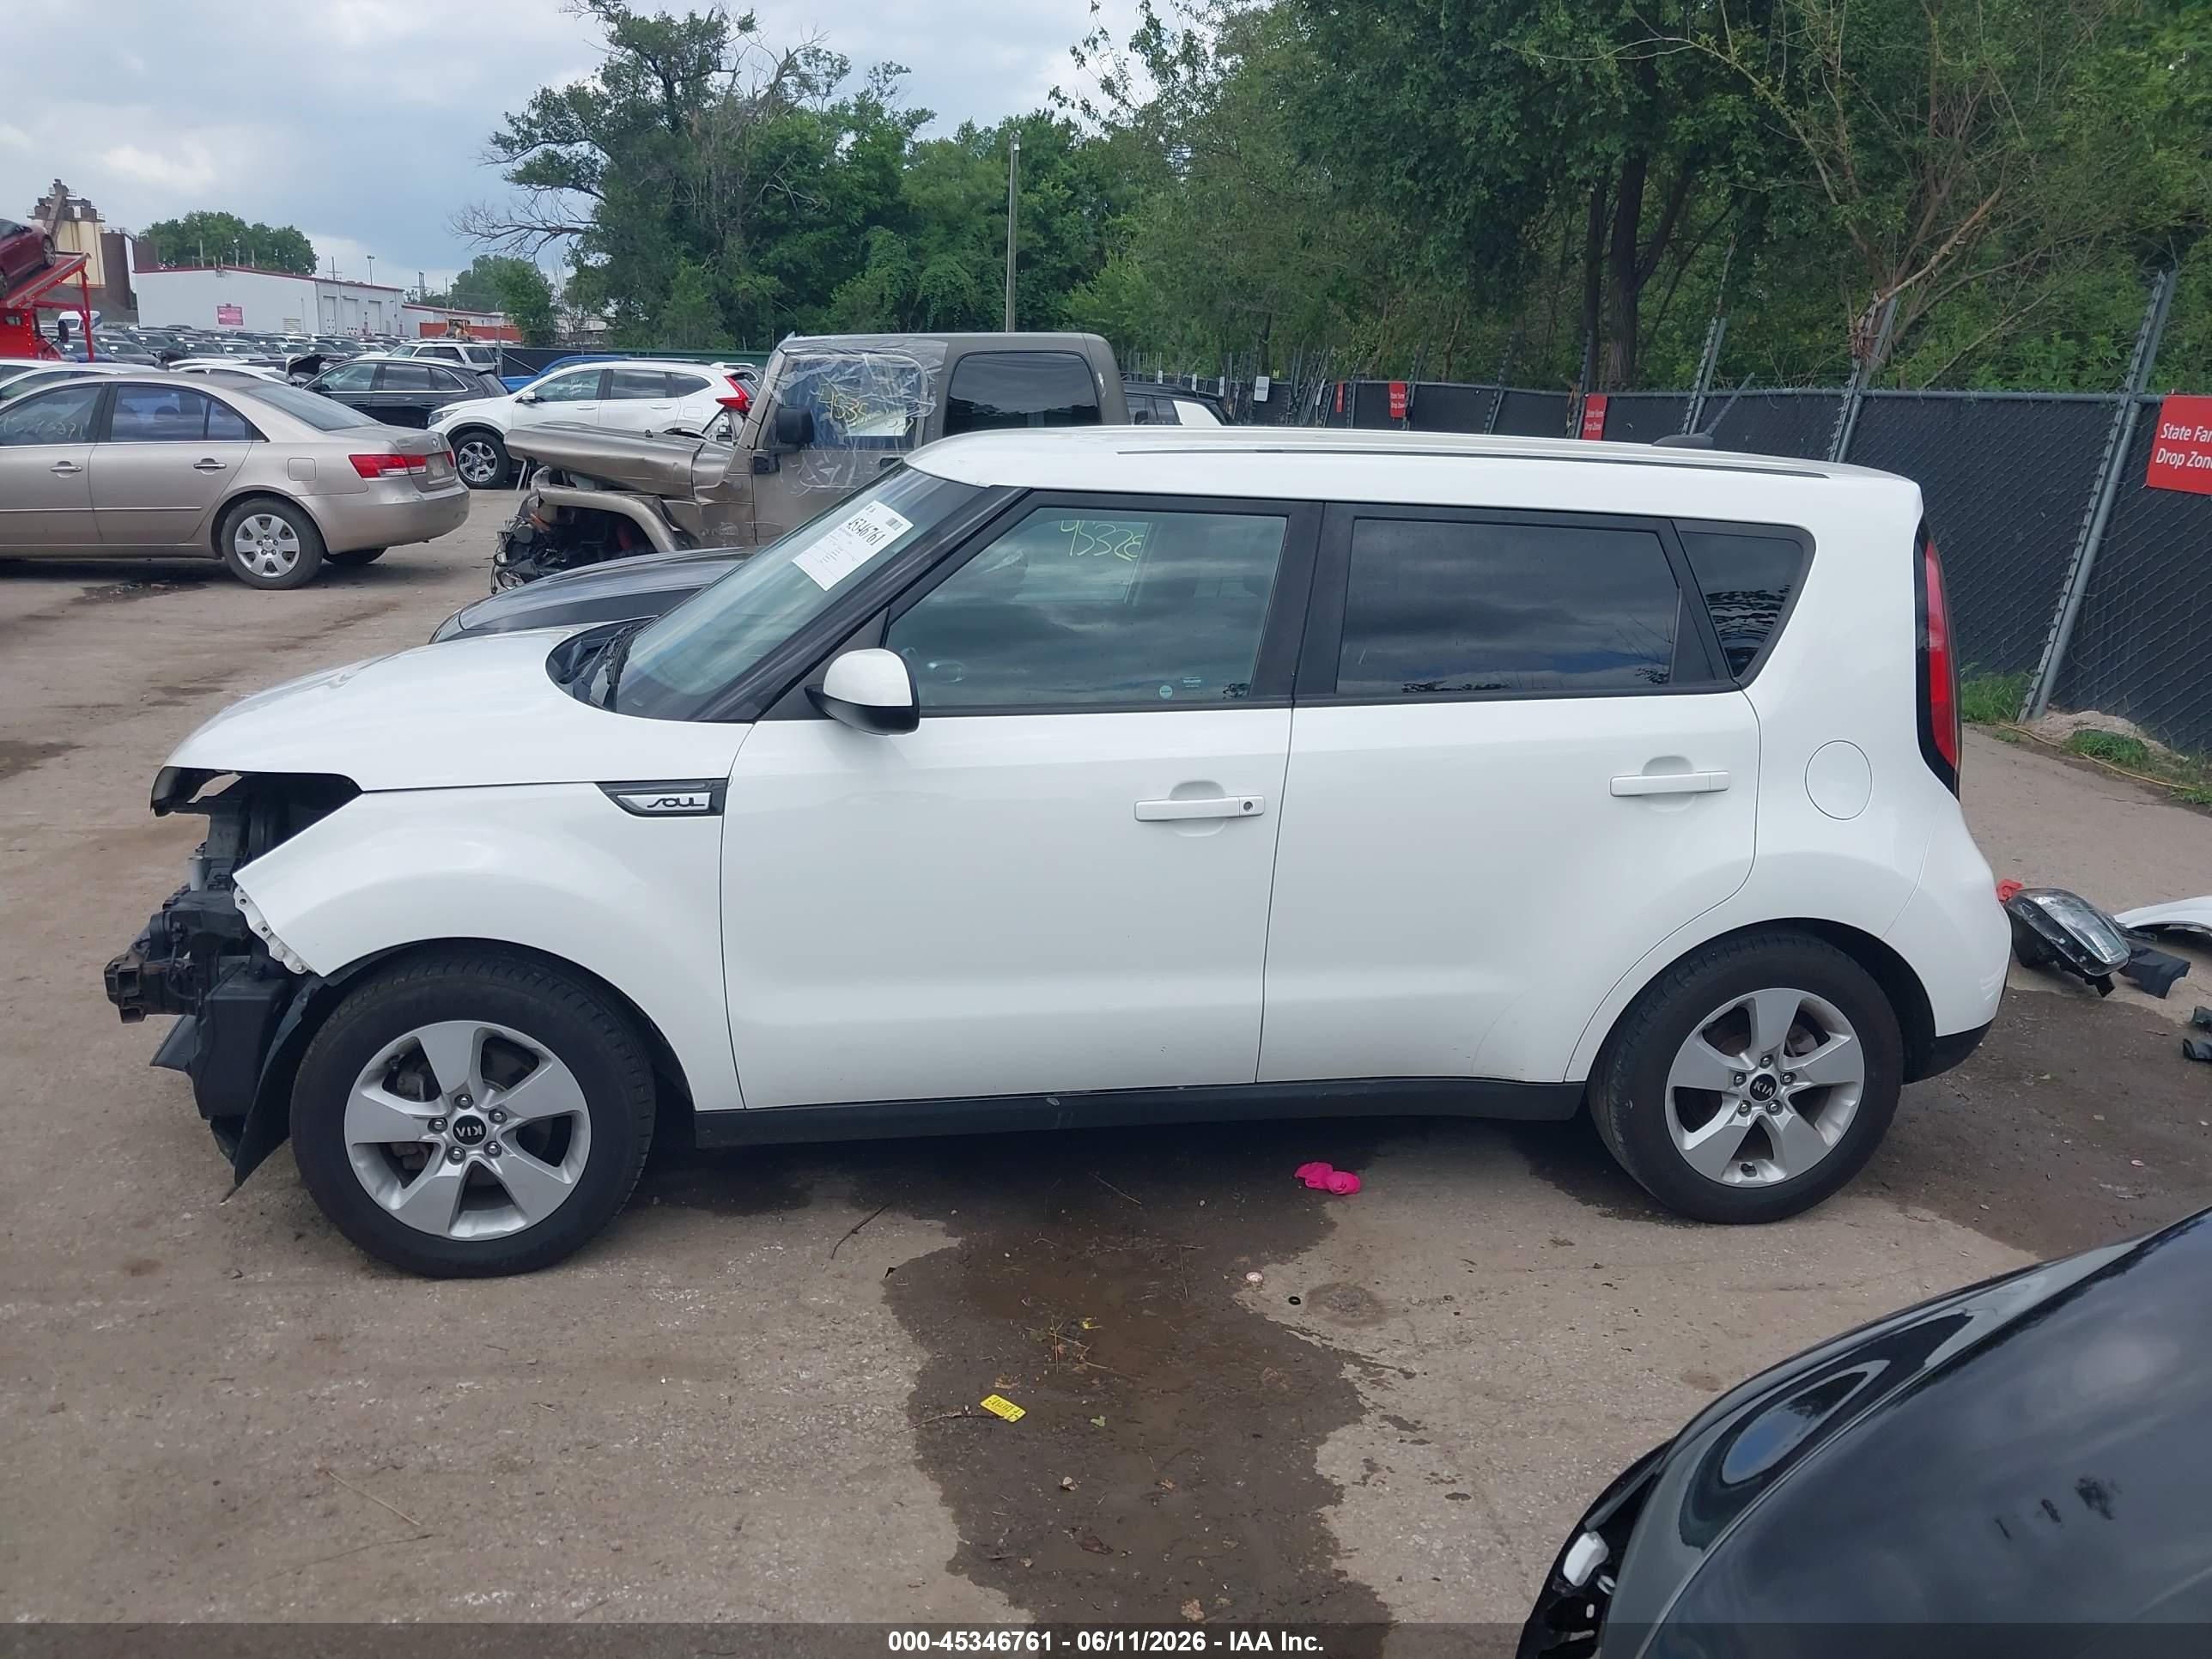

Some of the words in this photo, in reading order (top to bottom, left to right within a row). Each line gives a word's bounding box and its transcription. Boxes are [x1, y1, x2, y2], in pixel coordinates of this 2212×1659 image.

[2160, 422, 2192, 441] State
[2193, 425, 2212, 443] Far
[2155, 447, 2185, 470] Drop
[2186, 451, 2212, 470] Zon
[647, 797, 706, 808] SOUL
[1753, 1080, 1774, 1097] KIA
[455, 1124, 483, 1138] KIA
